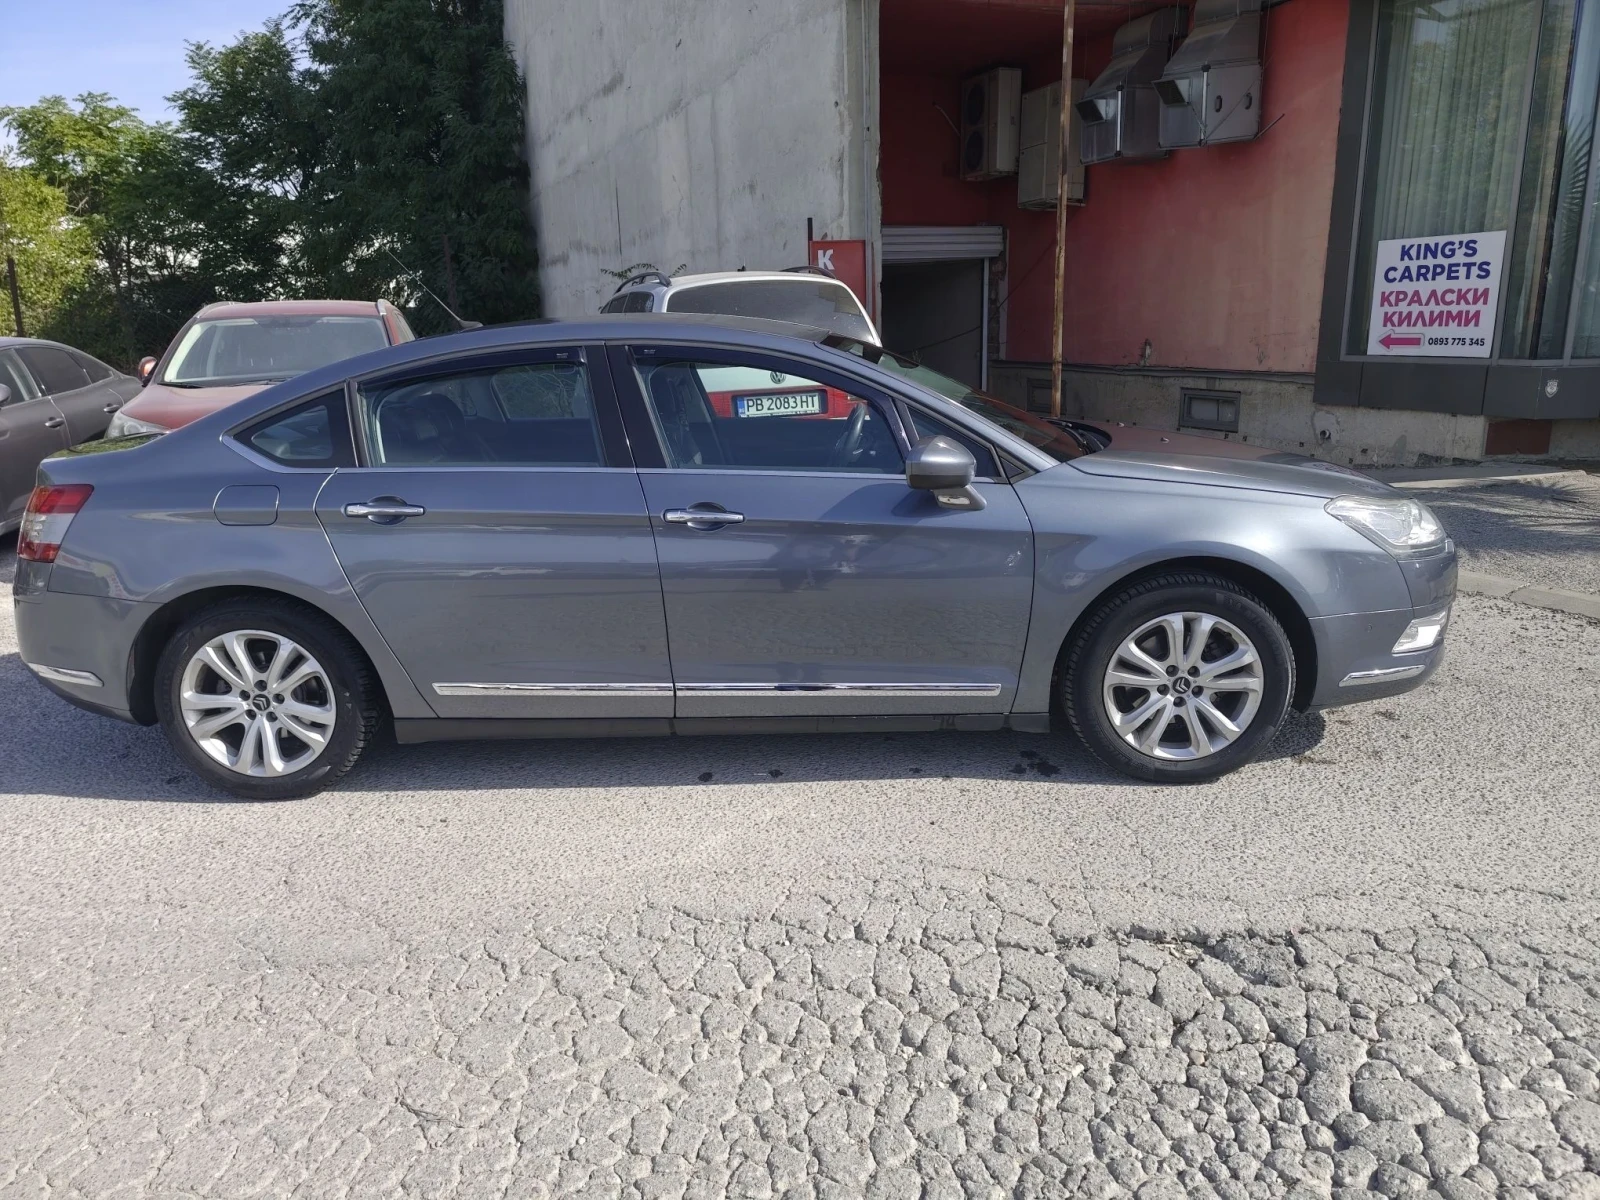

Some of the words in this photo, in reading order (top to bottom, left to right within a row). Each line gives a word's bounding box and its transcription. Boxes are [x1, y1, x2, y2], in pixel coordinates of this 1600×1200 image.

[817, 249, 835, 270] K
[1400, 239, 1478, 261] KING'S
[1383, 261, 1491, 283] CARPETS
[1380, 287, 1490, 307] КРАЛСКИ
[1382, 309, 1481, 327] КИЛИМИ
[1427, 337, 1449, 346] 0893
[1451, 337, 1466, 346] 775
[1468, 338, 1485, 346] 345
[746, 398, 764, 412] PB
[767, 396, 798, 411] 2083
[800, 394, 817, 409] HT
